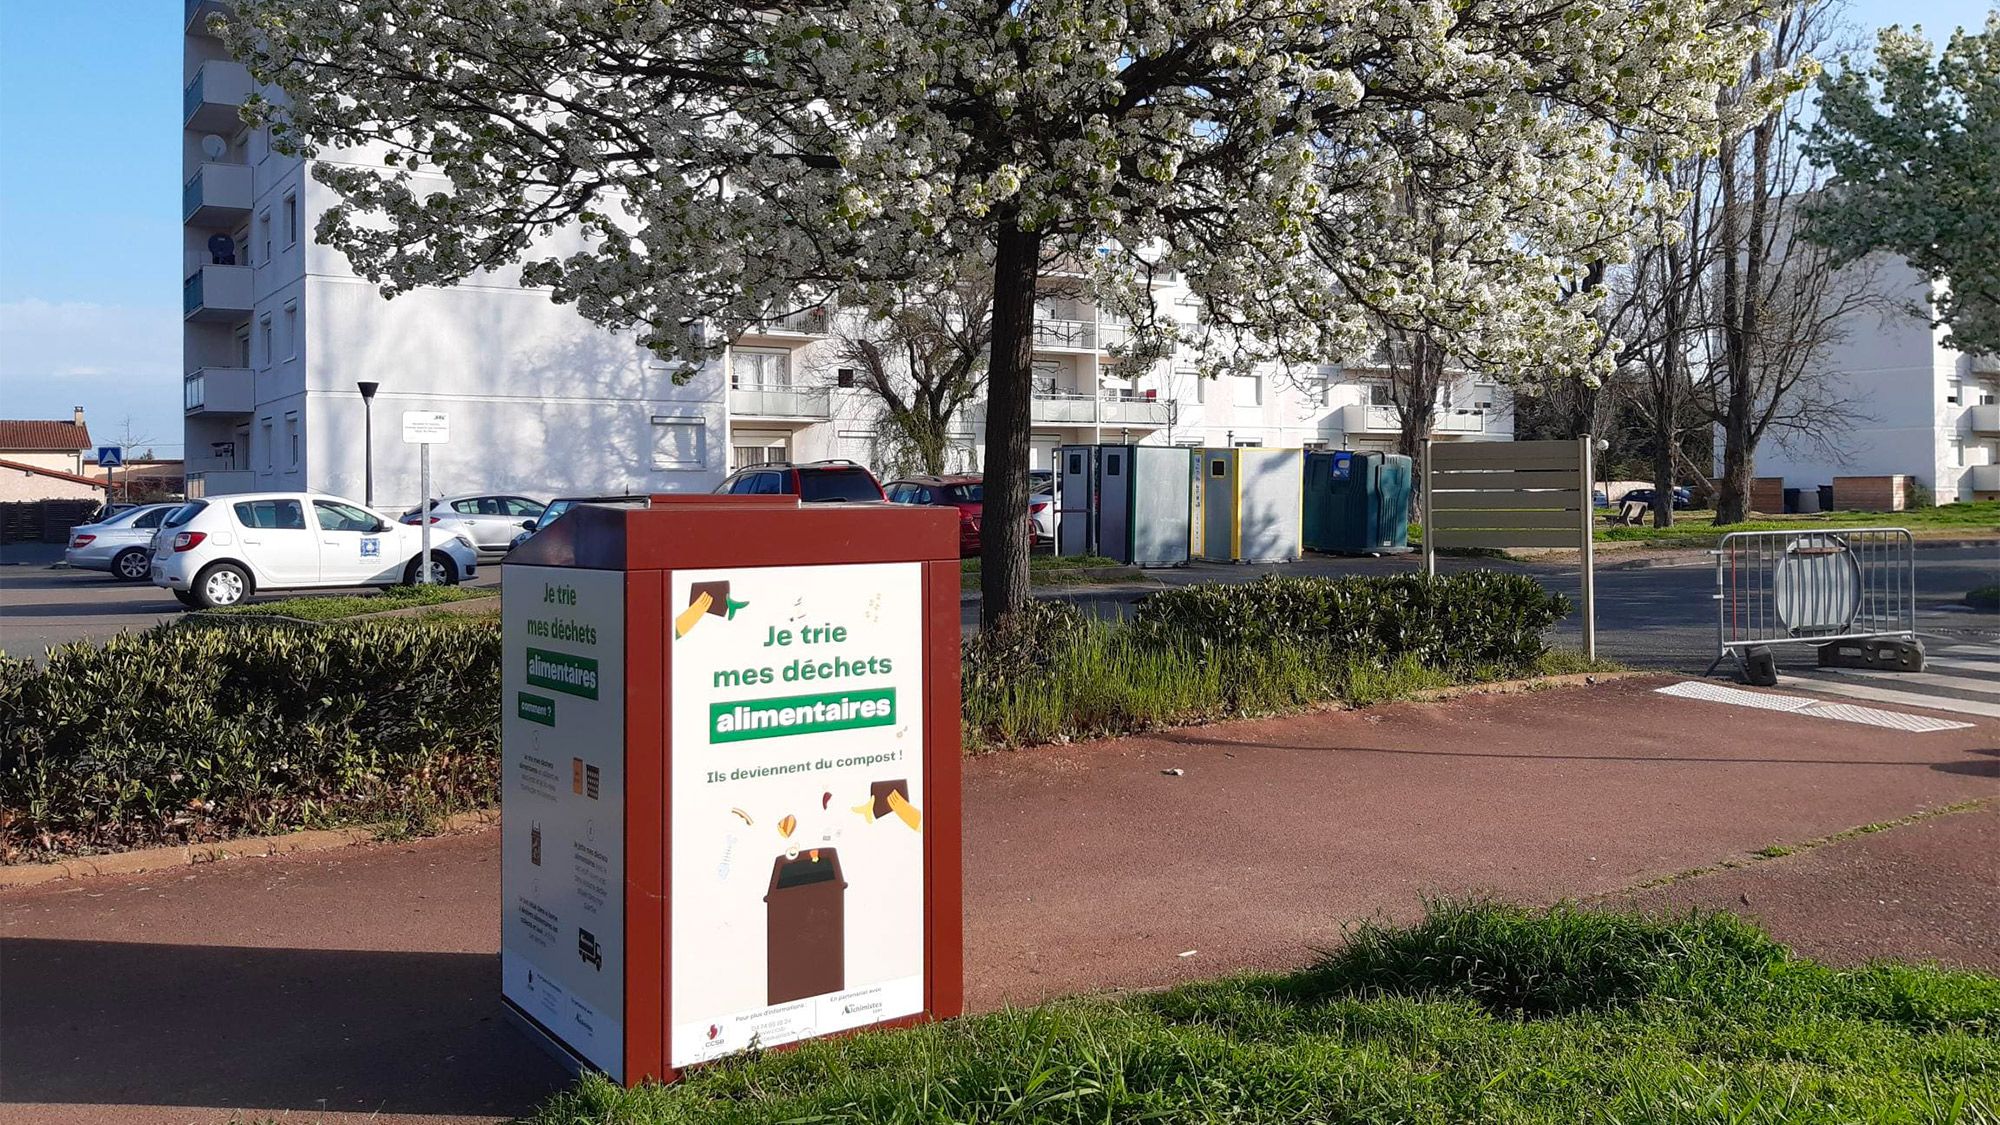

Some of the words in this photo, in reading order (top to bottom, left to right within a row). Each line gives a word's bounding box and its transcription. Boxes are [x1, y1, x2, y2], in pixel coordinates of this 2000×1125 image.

[543, 582, 555, 603] Je
[556, 584, 577, 606] trie
[527, 619, 548, 638] mes
[551, 618, 597, 646] déchets
[763, 625, 793, 647] Je
[801, 623, 847, 645] trie
[528, 654, 597, 689] alimentaires
[713, 666, 774, 688] mes
[782, 655, 893, 682] déchets
[716, 697, 892, 733] alimentaires
[707, 771, 727, 784] Ils
[730, 761, 811, 781] deviennent
[815, 758, 833, 770] du
[836, 751, 896, 768] compost
